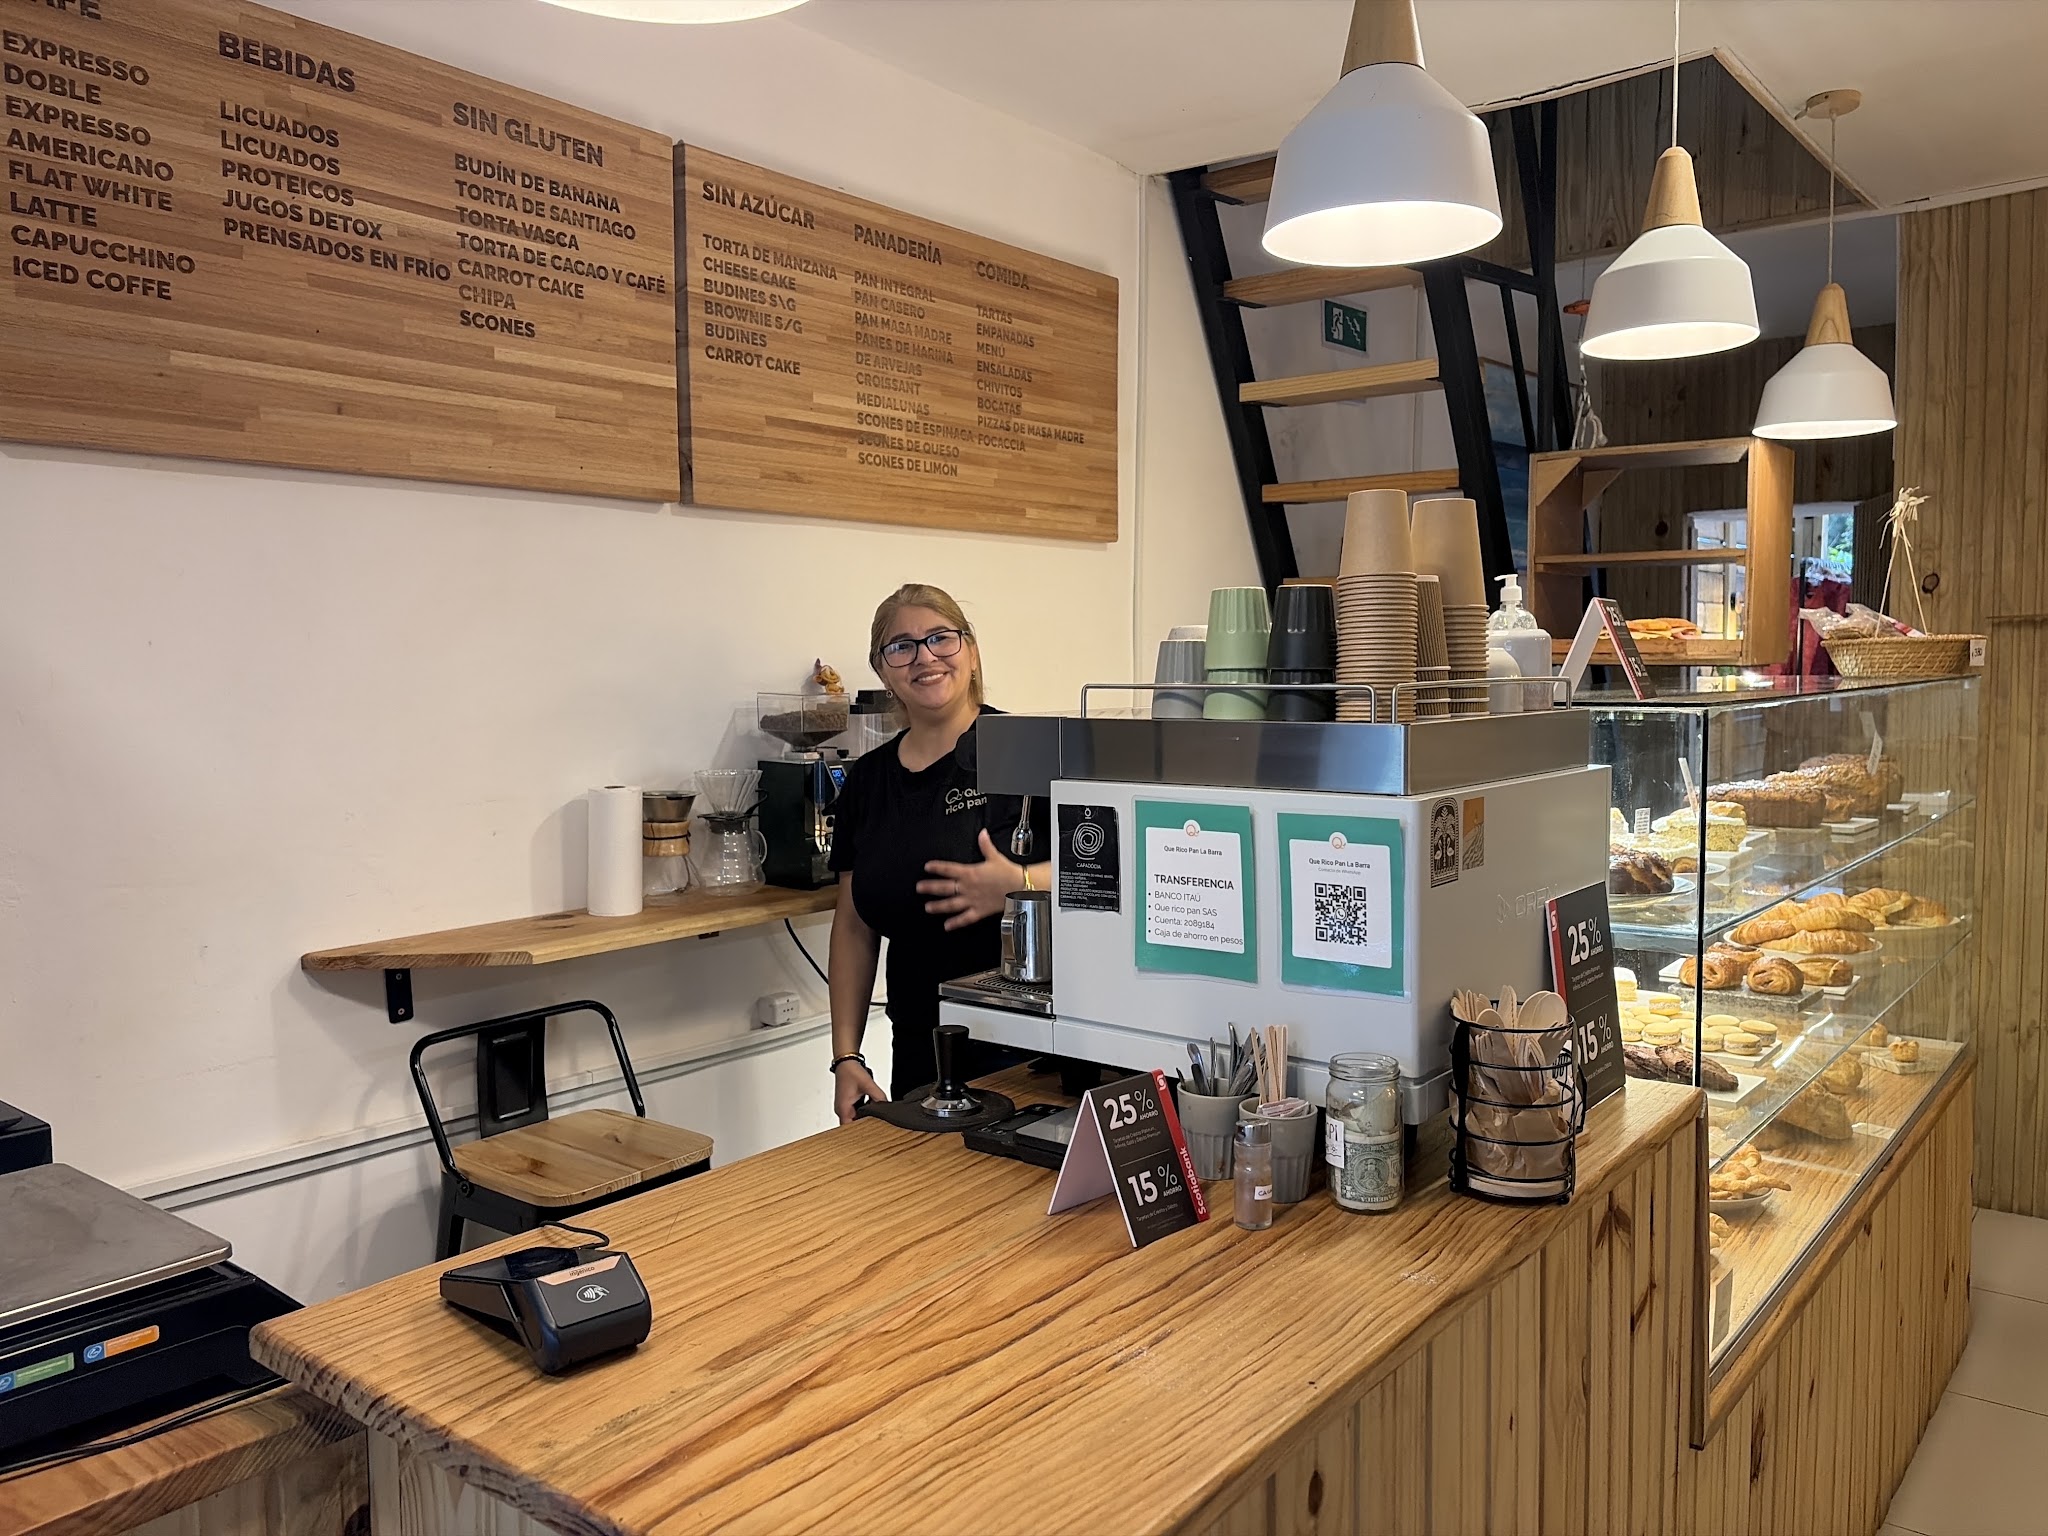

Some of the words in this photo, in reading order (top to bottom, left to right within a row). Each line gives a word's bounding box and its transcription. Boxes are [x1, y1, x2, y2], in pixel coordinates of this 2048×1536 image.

[2, 29, 150, 86] EXPRESSO
[218, 31, 356, 92] BEBIDAS
[4, 62, 102, 105] DOBLE
[5, 95, 151, 146] EXPRESSO
[220, 100, 340, 148] LICUADOS
[453, 102, 498, 135] SIN
[504, 118, 603, 167] GLUTEN
[6, 128, 174, 181] AMERICANO
[220, 129, 341, 175] LICUADOS
[9, 160, 77, 191] FLAT
[82, 175, 173, 211] WHITE
[222, 159, 354, 206] PROTEICOS
[454, 153, 516, 185] BUDÍN
[521, 172, 545, 193] DE
[549, 180, 621, 213] BANANA
[10, 192, 97, 227] LATTE
[222, 189, 303, 222] JUGOS
[309, 207, 383, 241] DETOX
[455, 179, 518, 211] TORTA
[522, 197, 545, 217] DE
[549, 205, 636, 240] SANTIAGO
[702, 180, 736, 208] SIN
[739, 192, 815, 230] AZÚCAR
[455, 206, 519, 237] TORTA
[521, 222, 580, 250] VASCA
[854, 223, 942, 265] PANADERÍA
[11, 225, 195, 274] CAPUCCHINO
[223, 218, 364, 263] PRENSADOS
[370, 249, 398, 271] EN
[403, 257, 451, 281] FRÍO
[456, 232, 519, 261] TORTA
[523, 247, 547, 268] DE
[551, 255, 609, 281] CACAO
[612, 268, 623, 284] Y
[625, 275, 666, 294] CAFÉ
[703, 233, 750, 259] TORTA
[752, 247, 770, 264] DE
[773, 252, 838, 280] MANZANA
[13, 256, 79, 285] ICED
[86, 269, 172, 300] COFFE
[458, 258, 535, 289] CARROT
[538, 276, 585, 299] CAKE
[703, 257, 757, 282] CHEESE
[761, 270, 796, 290] CAKE
[854, 271, 878, 288] PAN
[881, 278, 936, 303] INTEGRAL
[976, 260, 1030, 290] COMIDA
[458, 284, 516, 310] CHIPA
[704, 278, 766, 305] BUDINES
[769, 294, 796, 311] S\G
[854, 291, 878, 308] PAN
[881, 298, 925, 319] CASERO
[460, 310, 536, 338] SCONES
[704, 300, 772, 328] BROWNIE
[775, 318, 803, 334] S/G
[855, 311, 878, 328] PAN
[881, 317, 913, 336] MASA
[915, 325, 952, 345] MADRE
[976, 305, 1013, 324] TARTAS
[705, 323, 767, 348] BUDINES
[856, 331, 892, 351] PANES
[895, 340, 910, 355] DE
[913, 343, 954, 364] HARINA
[976, 323, 1035, 347] EMPANADAS
[705, 345, 762, 368] CARROT
[765, 357, 800, 375] CAKE
[856, 352, 871, 366] DE
[873, 356, 922, 376] ARVEJAS
[977, 360, 1032, 383] ENSALADAS
[856, 372, 921, 395] CROISSANT
[977, 379, 1023, 398] CHIVITOS
[857, 392, 930, 416] MEDIALUNAS
[977, 397, 1022, 415] BOCATAS
[857, 412, 903, 431] SCONES
[906, 420, 920, 434] DE
[923, 422, 975, 442] ESPINACA
[977, 415, 1011, 432] PIZZAS
[1013, 422, 1025, 434] DE
[1028, 424, 1052, 439] MASA
[1054, 429, 1085, 444] MADRE
[977, 434, 1026, 452] FOCACCIA
[857, 432, 904, 451] SCONES
[906, 439, 921, 452] DE
[923, 442, 960, 458] QUESO
[858, 452, 904, 470] SCONES
[907, 459, 921, 472] DE
[945, 803, 964, 815] rico
[967, 796, 987, 809] pan
[964, 788, 985, 797] Qu
[1154, 874, 1234, 890] TRANSFERENCIA
[1154, 891, 1182, 900] BANCO
[1154, 903, 1169, 912] Que
[1172, 905, 1185, 913] rico
[1187, 907, 1200, 915] pan
[1202, 908, 1217, 916] SAS
[1154, 916, 1182, 925] Cuenta:
[1184, 919, 1215, 930] 2089184
[1154, 928, 1170, 938] Caja
[1172, 930, 1182, 938] de
[1184, 931, 1208, 941] ahorro
[1220, 936, 1243, 945] pesos
[1140, 1109, 1159, 1120] AHORRO
[1163, 1185, 1183, 1197] AHORRO
[1179, 1146, 1208, 1216] Scotiabank
